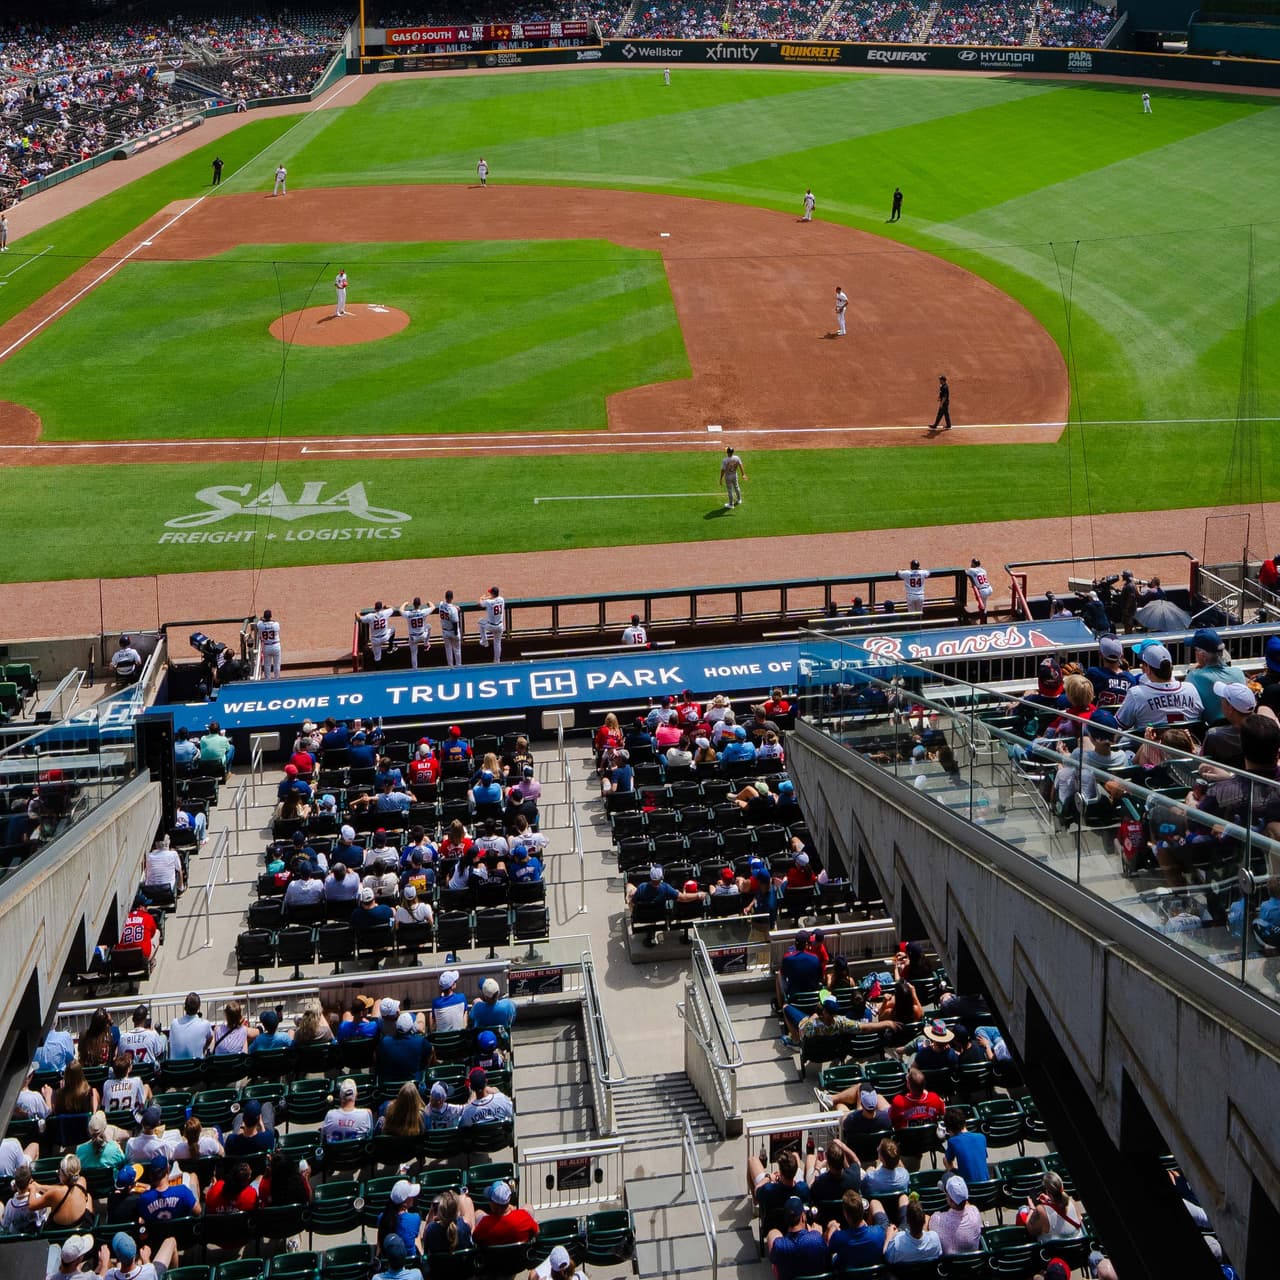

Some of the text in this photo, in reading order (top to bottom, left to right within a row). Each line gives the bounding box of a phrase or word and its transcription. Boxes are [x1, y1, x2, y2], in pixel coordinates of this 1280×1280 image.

[392, 31, 451, 41] GAS SOUTH
[458, 30, 469, 38] AL
[638, 47, 682, 57] Wellstar
[706, 44, 759, 61] xfinity
[780, 45, 841, 58] QUIKRETE
[867, 49, 928, 62] EQUIFAX
[981, 52, 1034, 62] HYUNDAI
[1068, 59, 1093, 68] JOHNS
[164, 480, 412, 528] SAIA
[158, 527, 402, 544] FREIGHT LOGISTICS
[863, 627, 1024, 660] Braves
[703, 661, 793, 679] HOME OF
[223, 666, 684, 714] WELCOME TO TRUIST PARK
[1148, 696, 1194, 710] FREEMAN
[124, 925, 144, 943] 28
[127, 1036, 146, 1044] RILEY
